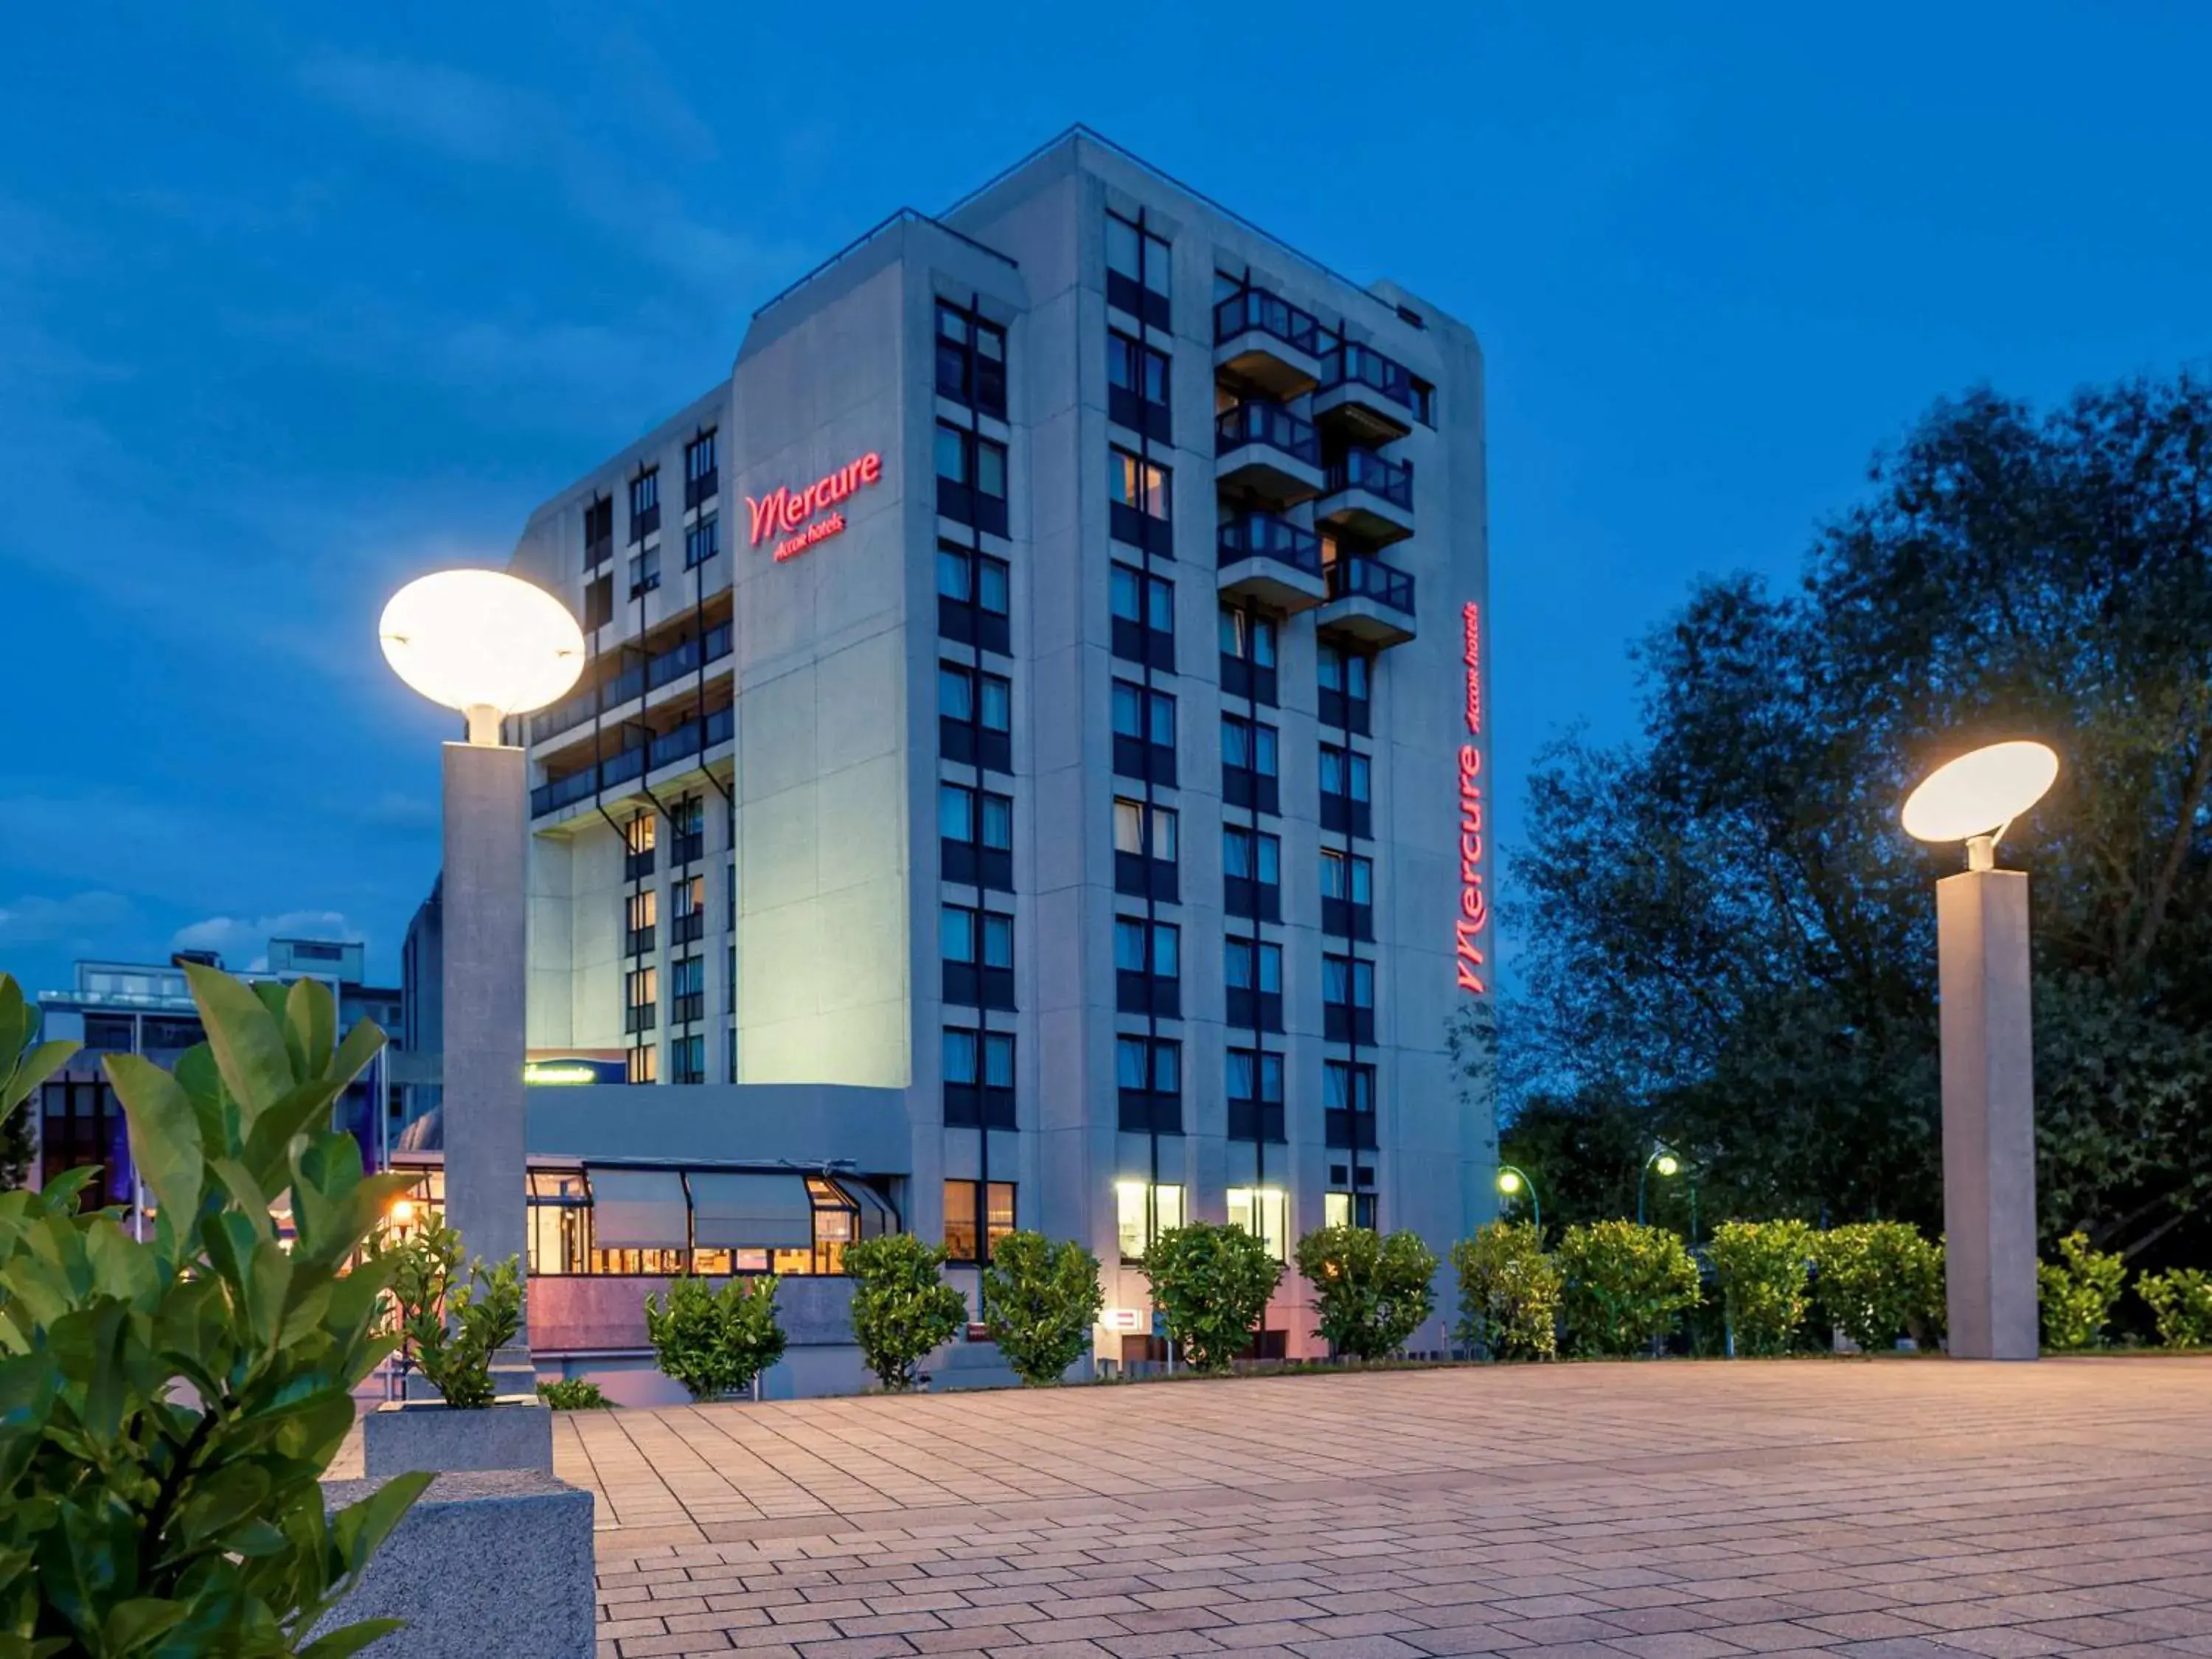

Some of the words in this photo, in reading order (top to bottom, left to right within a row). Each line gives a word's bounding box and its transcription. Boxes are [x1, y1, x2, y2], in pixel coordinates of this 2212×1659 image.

[745, 451, 883, 546] Mercure
[1463, 601, 1479, 667] hotels
[1457, 744, 1486, 993] Mercure
